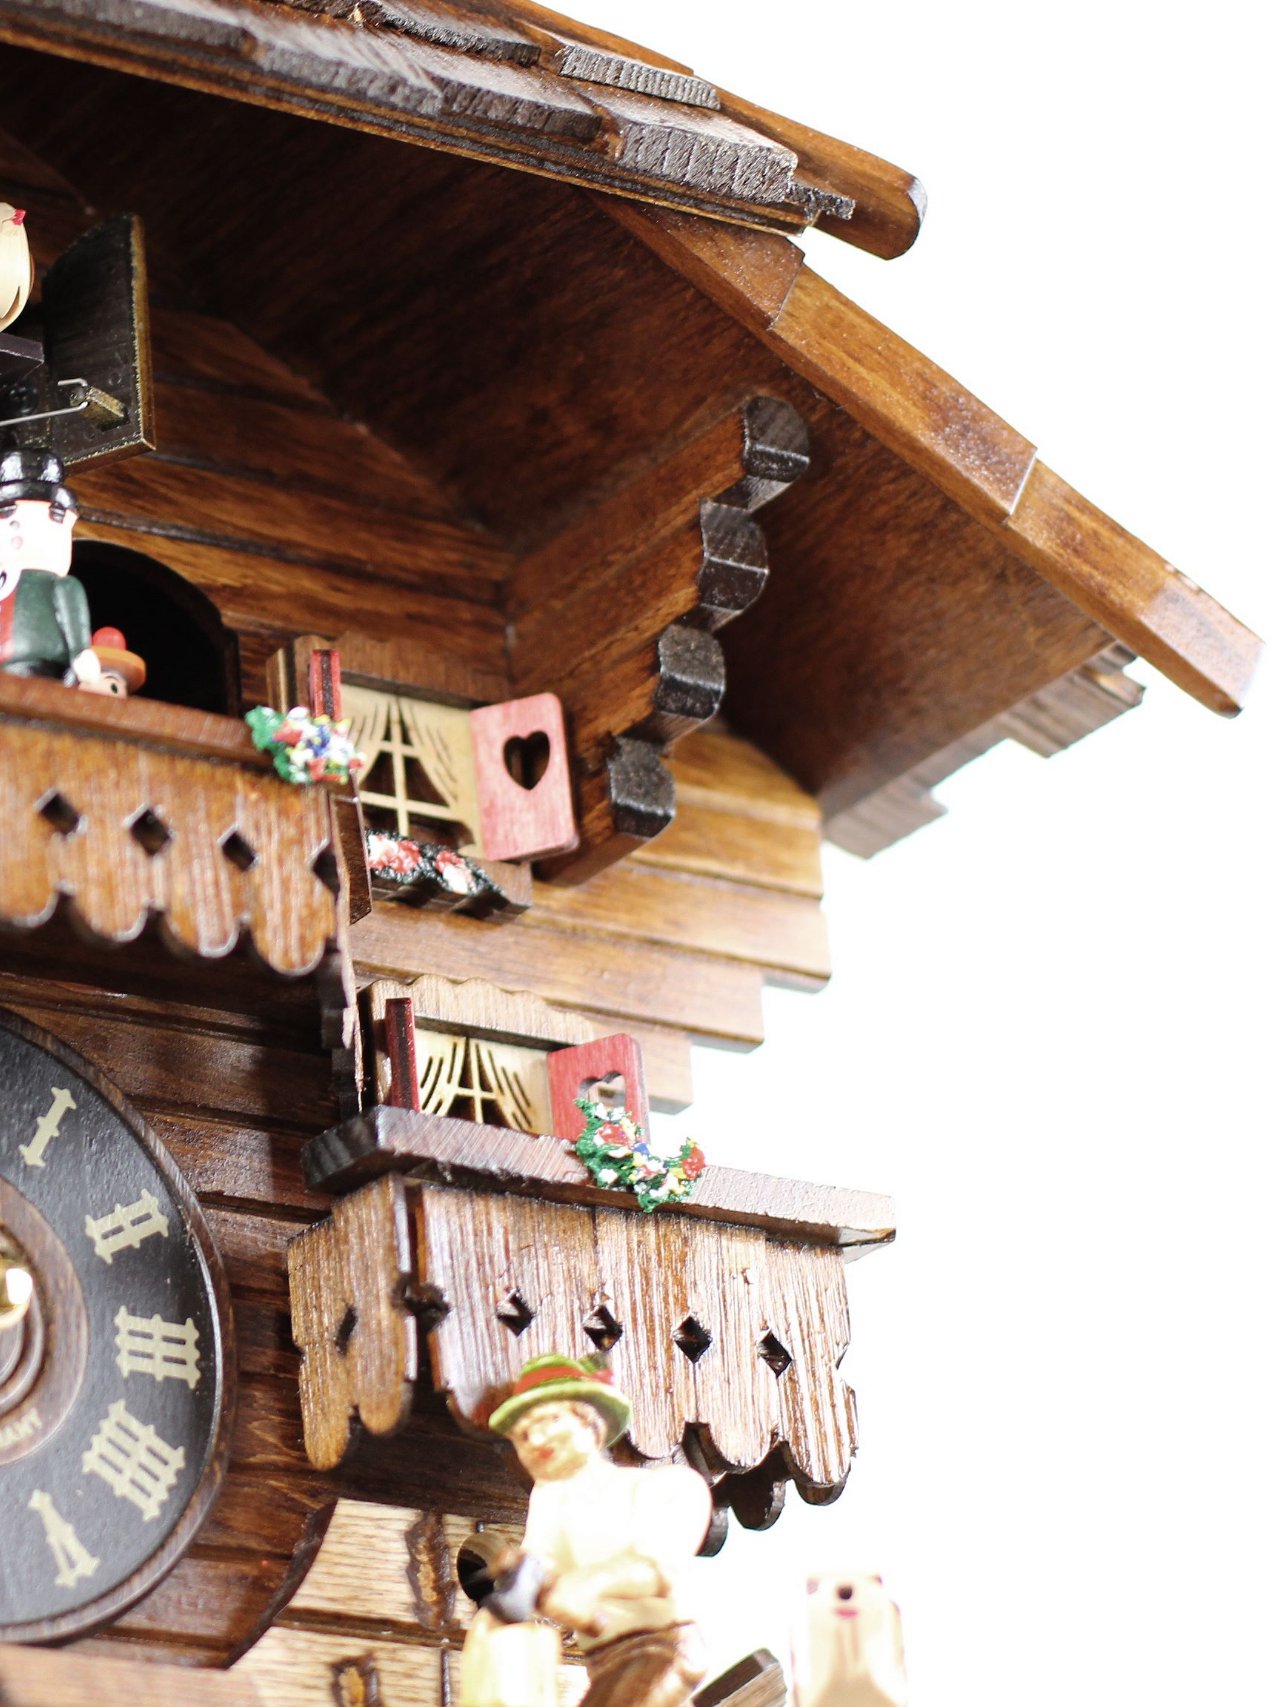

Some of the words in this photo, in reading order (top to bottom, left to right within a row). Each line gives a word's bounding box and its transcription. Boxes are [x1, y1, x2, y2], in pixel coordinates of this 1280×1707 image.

[19, 1086, 76, 1168] I
[85, 1189, 168, 1264] II
[114, 1305, 201, 1390] III
[82, 1399, 186, 1521] IIII
[28, 1489, 101, 1589] V
